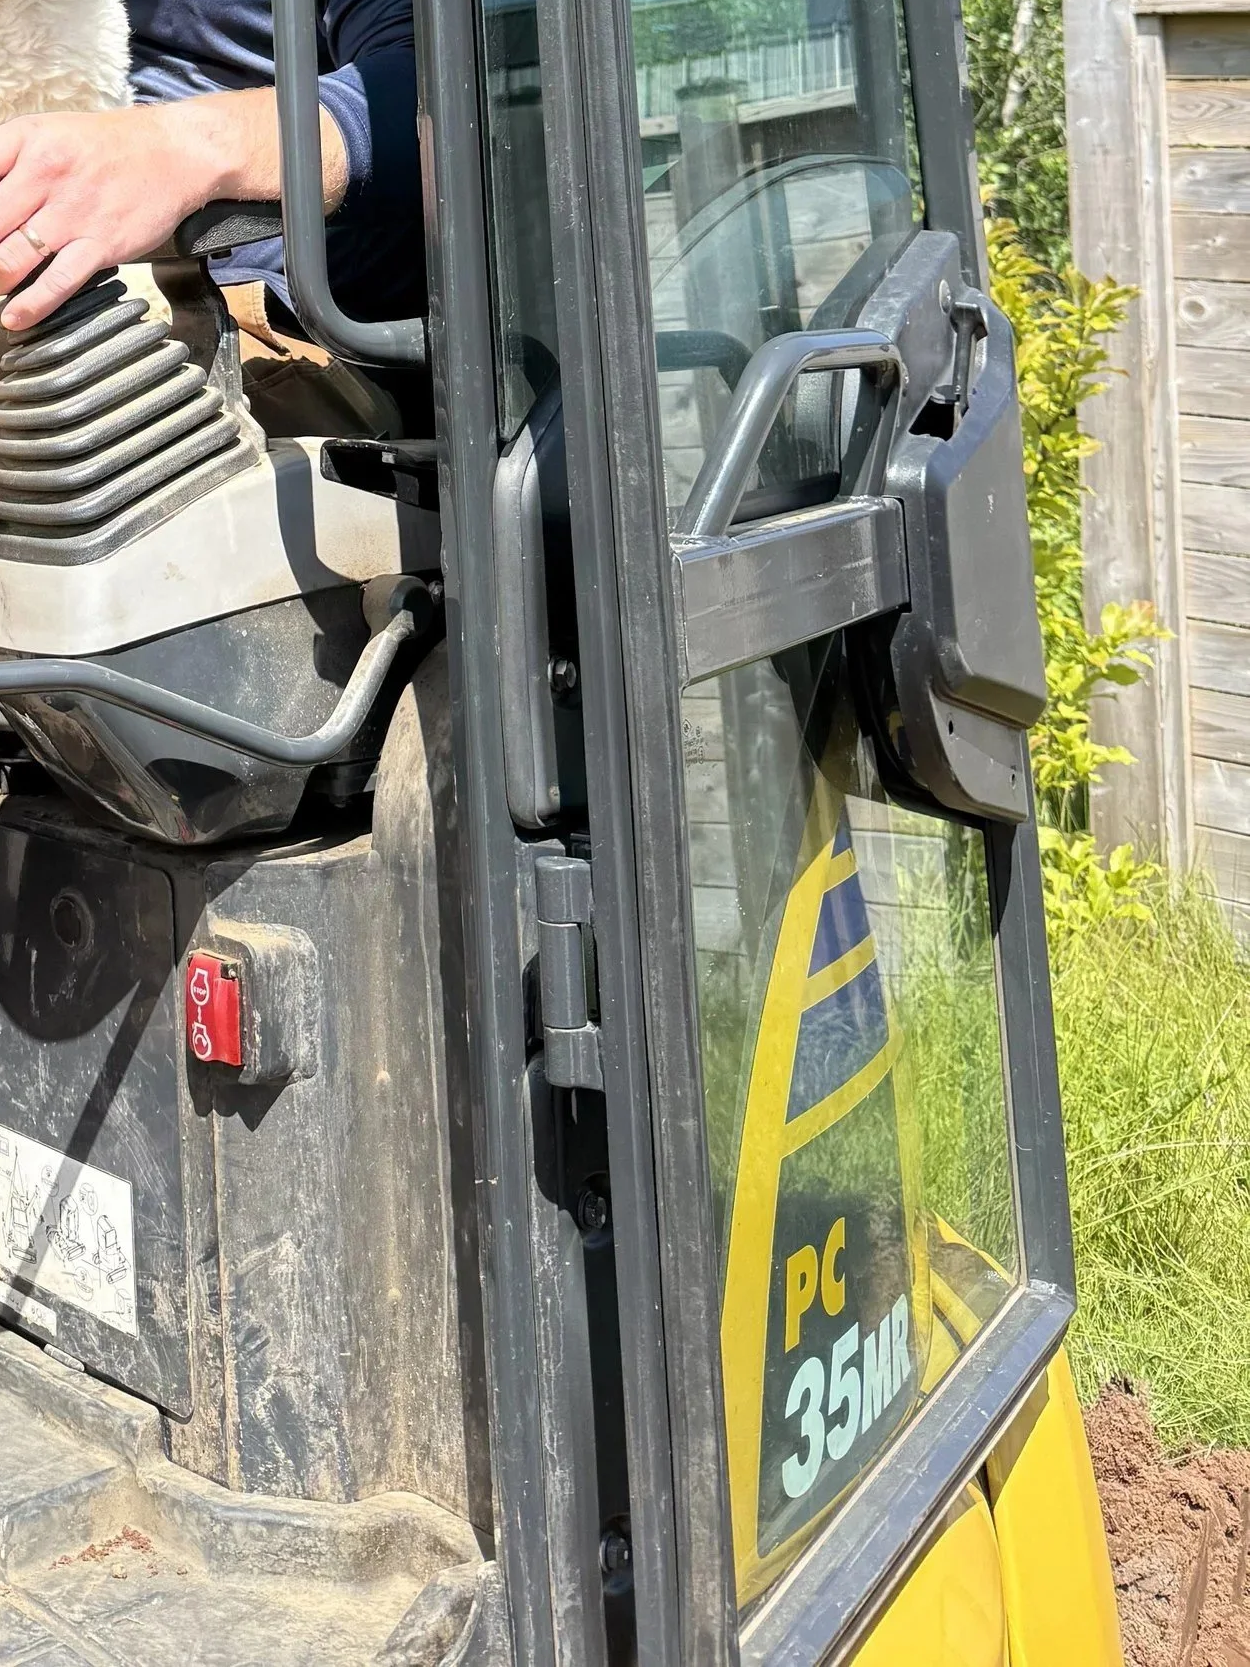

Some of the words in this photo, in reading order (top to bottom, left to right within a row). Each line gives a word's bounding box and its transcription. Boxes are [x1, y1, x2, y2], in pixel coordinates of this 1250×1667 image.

[193, 986, 207, 996] STOP
[785, 1217, 845, 1354] PC
[782, 1294, 911, 1498] 35MR
